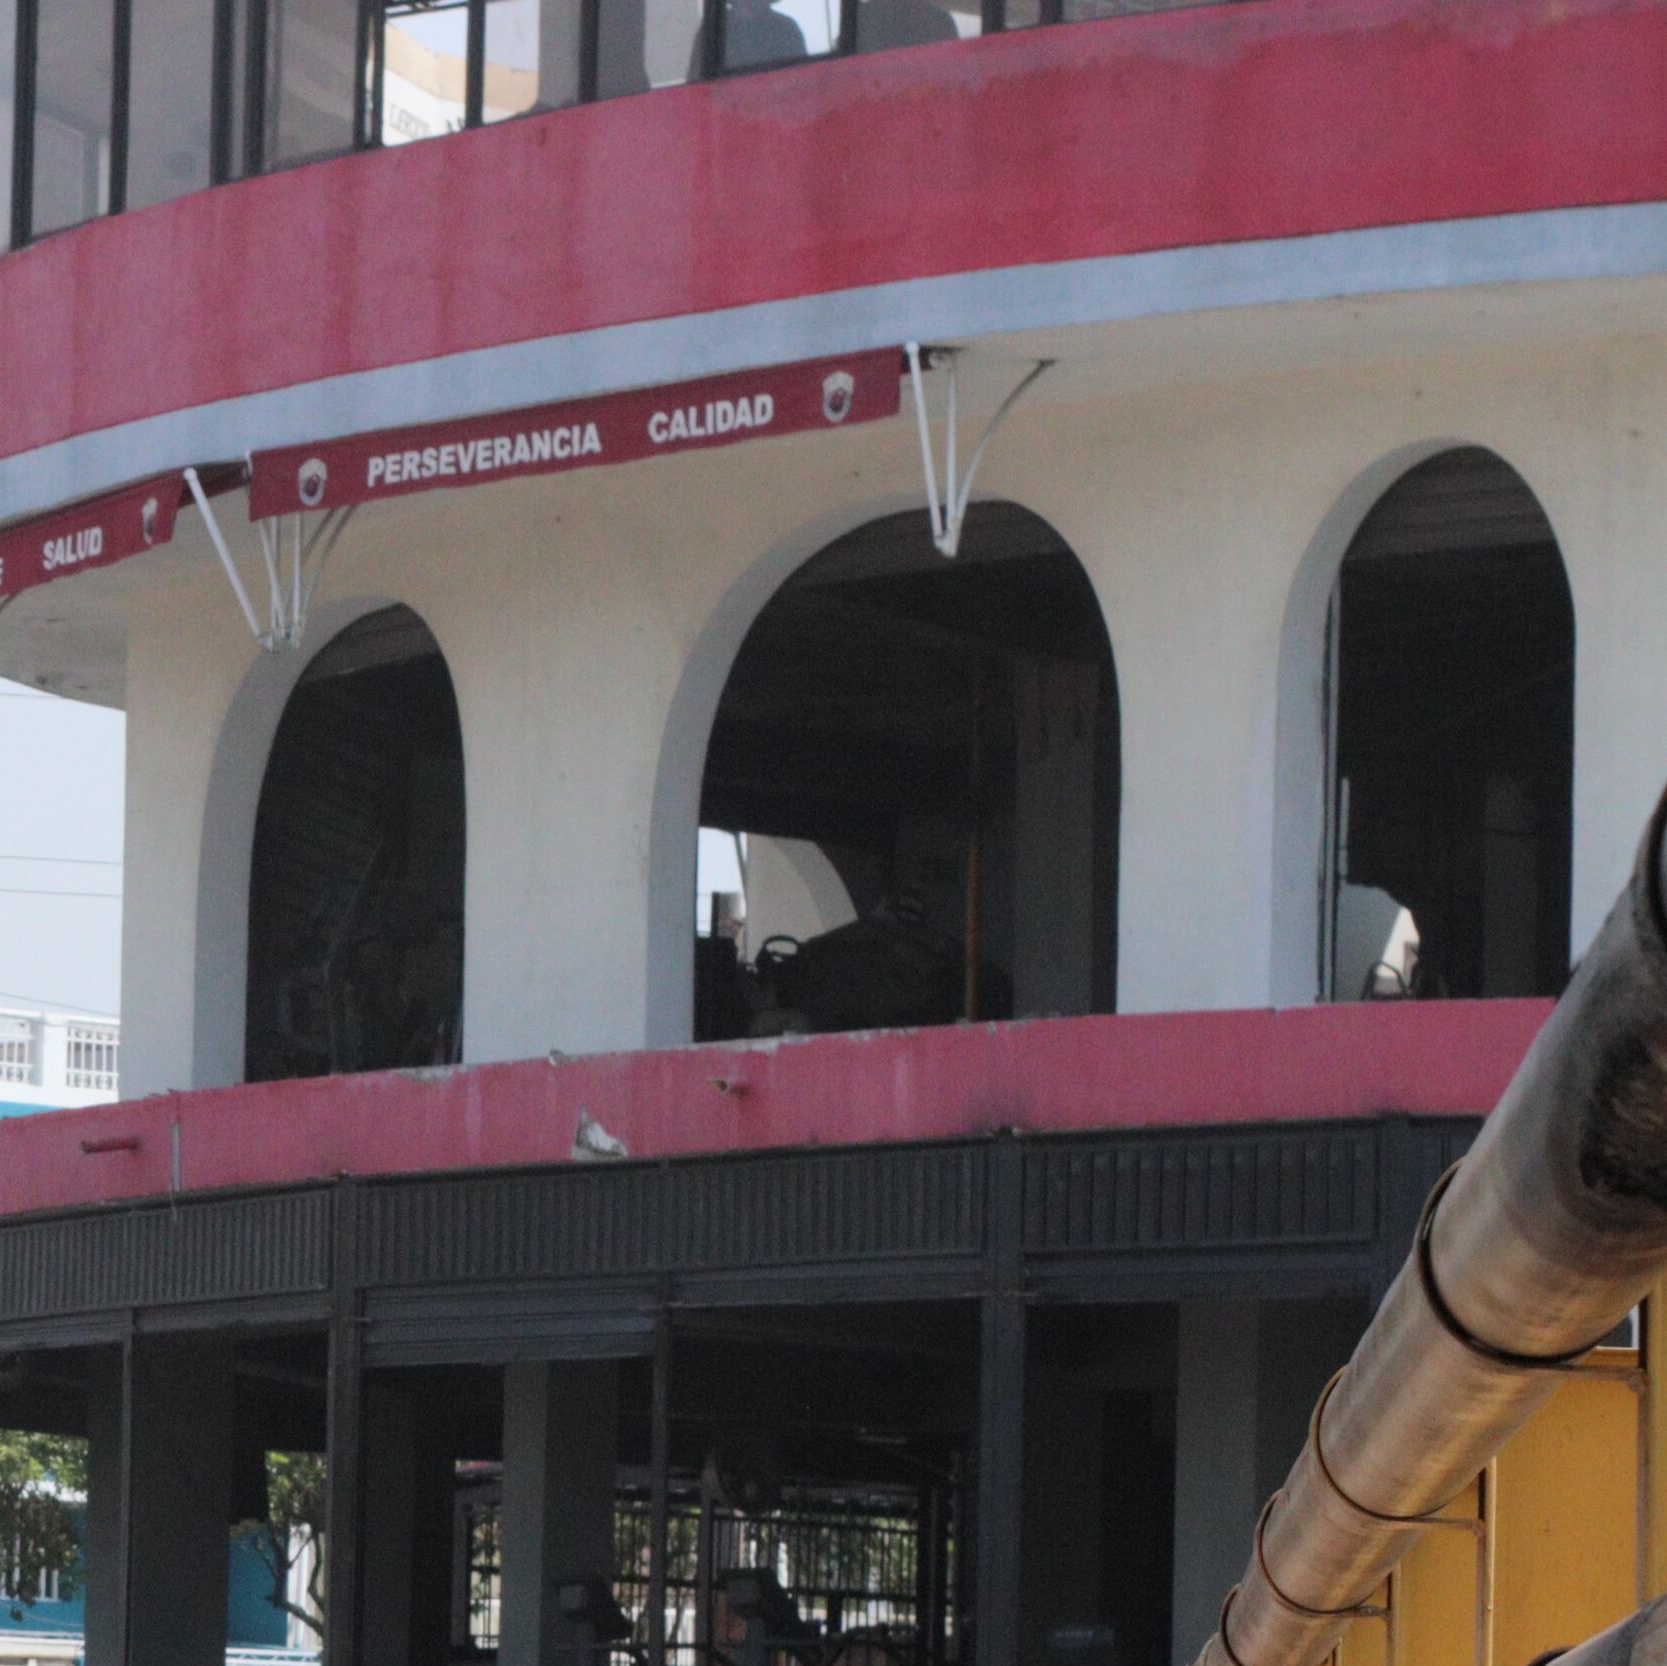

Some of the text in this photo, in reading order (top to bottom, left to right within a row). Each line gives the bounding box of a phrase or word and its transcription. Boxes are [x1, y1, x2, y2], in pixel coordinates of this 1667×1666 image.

[367, 394, 775, 488] PERSEVERANCIA CALIDAD
[42, 526, 103, 571] SALUD
